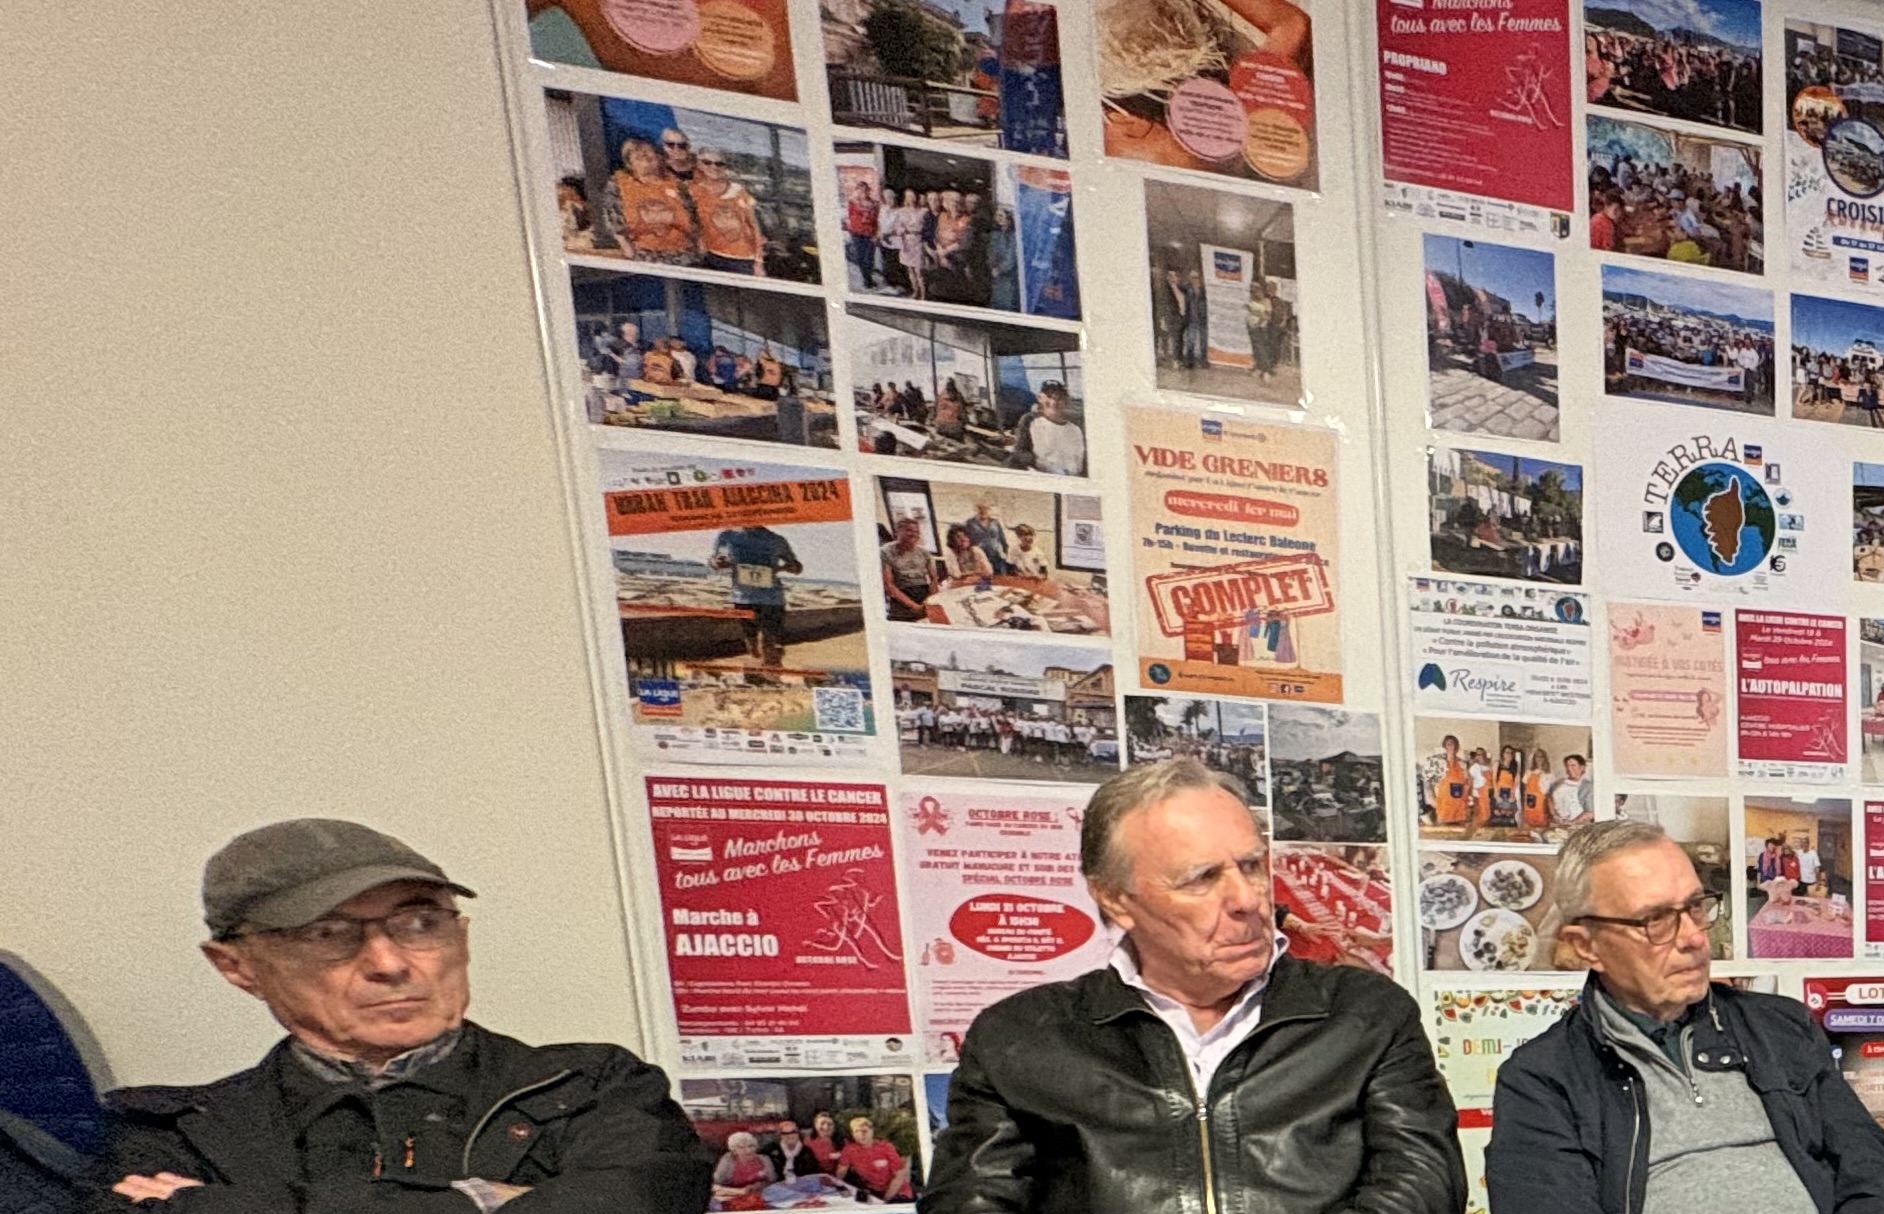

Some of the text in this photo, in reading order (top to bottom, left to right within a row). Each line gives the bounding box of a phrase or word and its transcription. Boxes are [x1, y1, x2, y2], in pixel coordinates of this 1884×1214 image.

[1391, 12, 1562, 33] tous avec les Femmes
[1384, 50, 1447, 76] PROPRIANO
[1134, 445, 1196, 471] VIDE
[1202, 454, 1329, 487] GRENIERS
[1644, 435, 1742, 505] TERRA
[797, 480, 840, 501] 2024
[1155, 523, 1202, 540] Parking
[1223, 529, 1266, 546] Leclerc
[1170, 567, 1314, 618] COMPLET
[1450, 668, 1516, 701] Respire
[1741, 678, 1843, 698] L'AUTOPALPATION
[653, 783, 883, 805] AVEC LA LIGUE CONTRE LE CANCER
[969, 809, 1018, 821] OCTOBRE
[724, 829, 823, 859] Marchons
[675, 843, 884, 889] tous avec les Femmes
[673, 907, 760, 926] Marche à
[676, 934, 779, 957] AJACCIO
[1830, 1014, 1868, 1027] SAMEDI
[1869, 1015, 1877, 1026] 7
